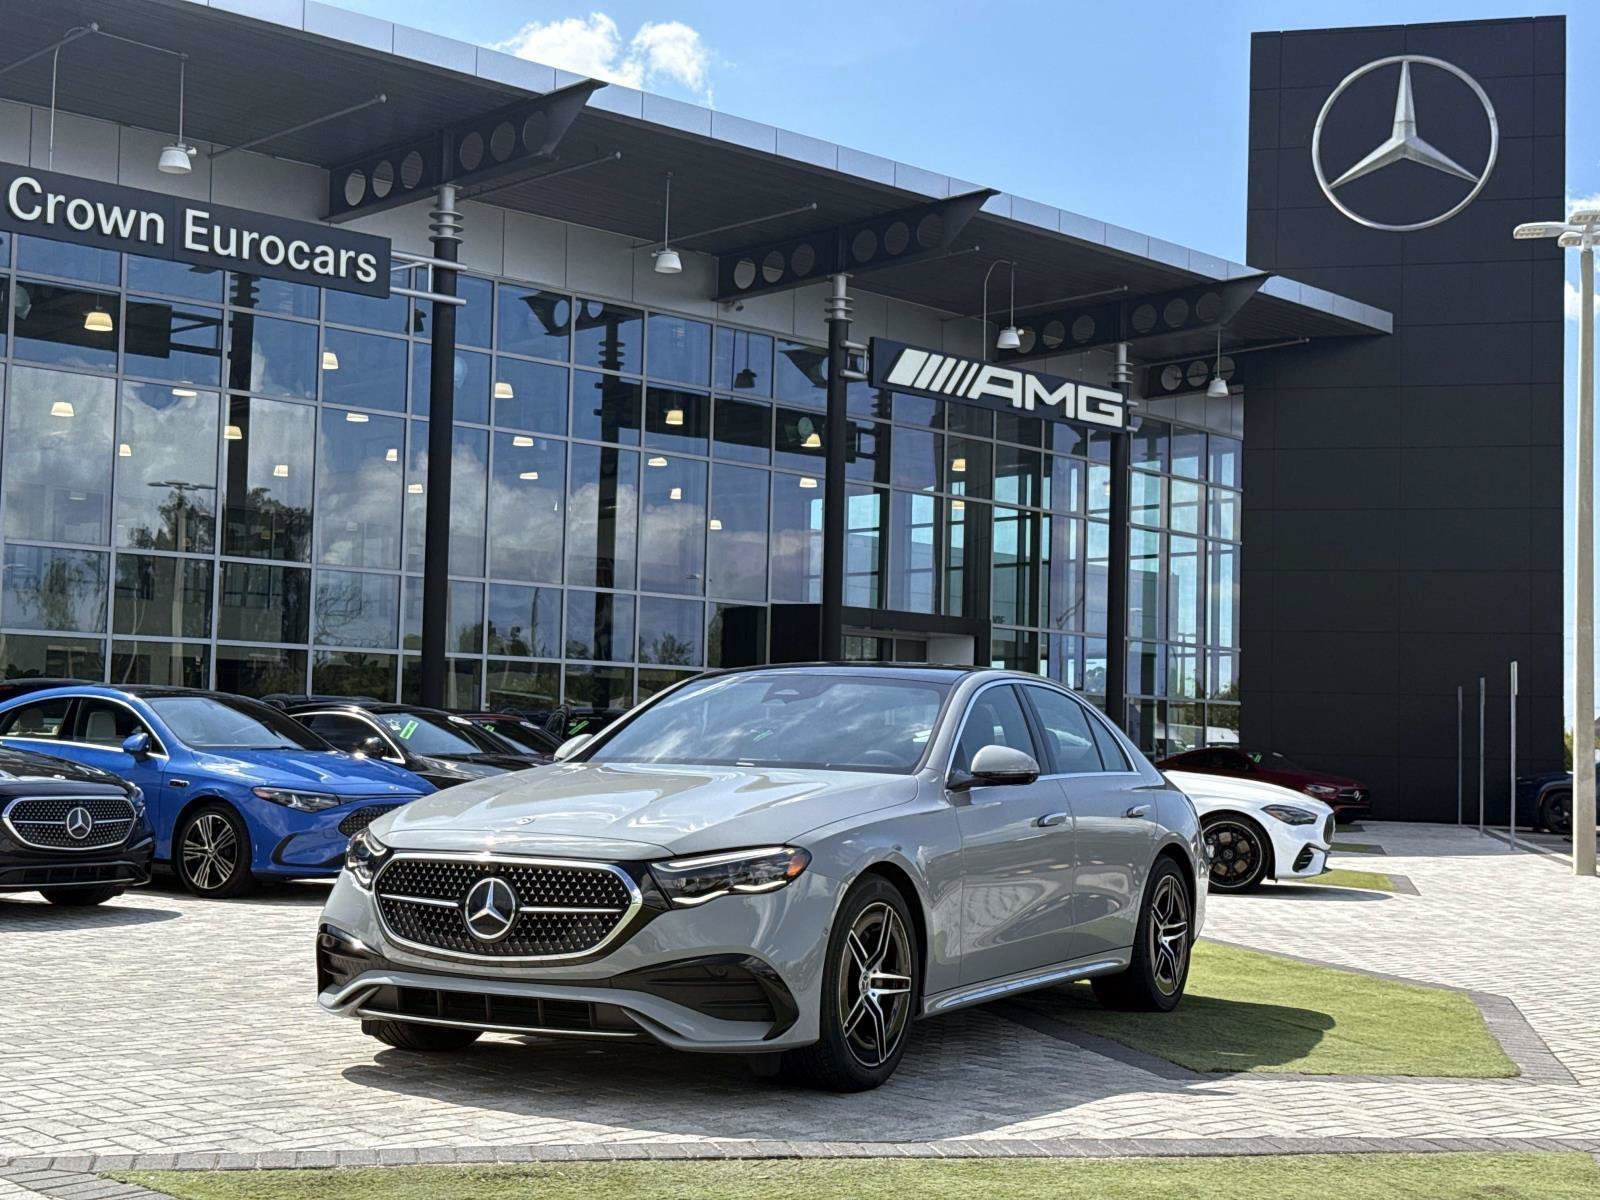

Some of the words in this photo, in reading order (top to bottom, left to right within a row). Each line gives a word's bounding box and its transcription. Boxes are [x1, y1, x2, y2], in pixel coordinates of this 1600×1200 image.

[8, 176, 165, 244] Crown
[184, 208, 377, 283] Eurocars
[967, 364, 1123, 428] AMG
